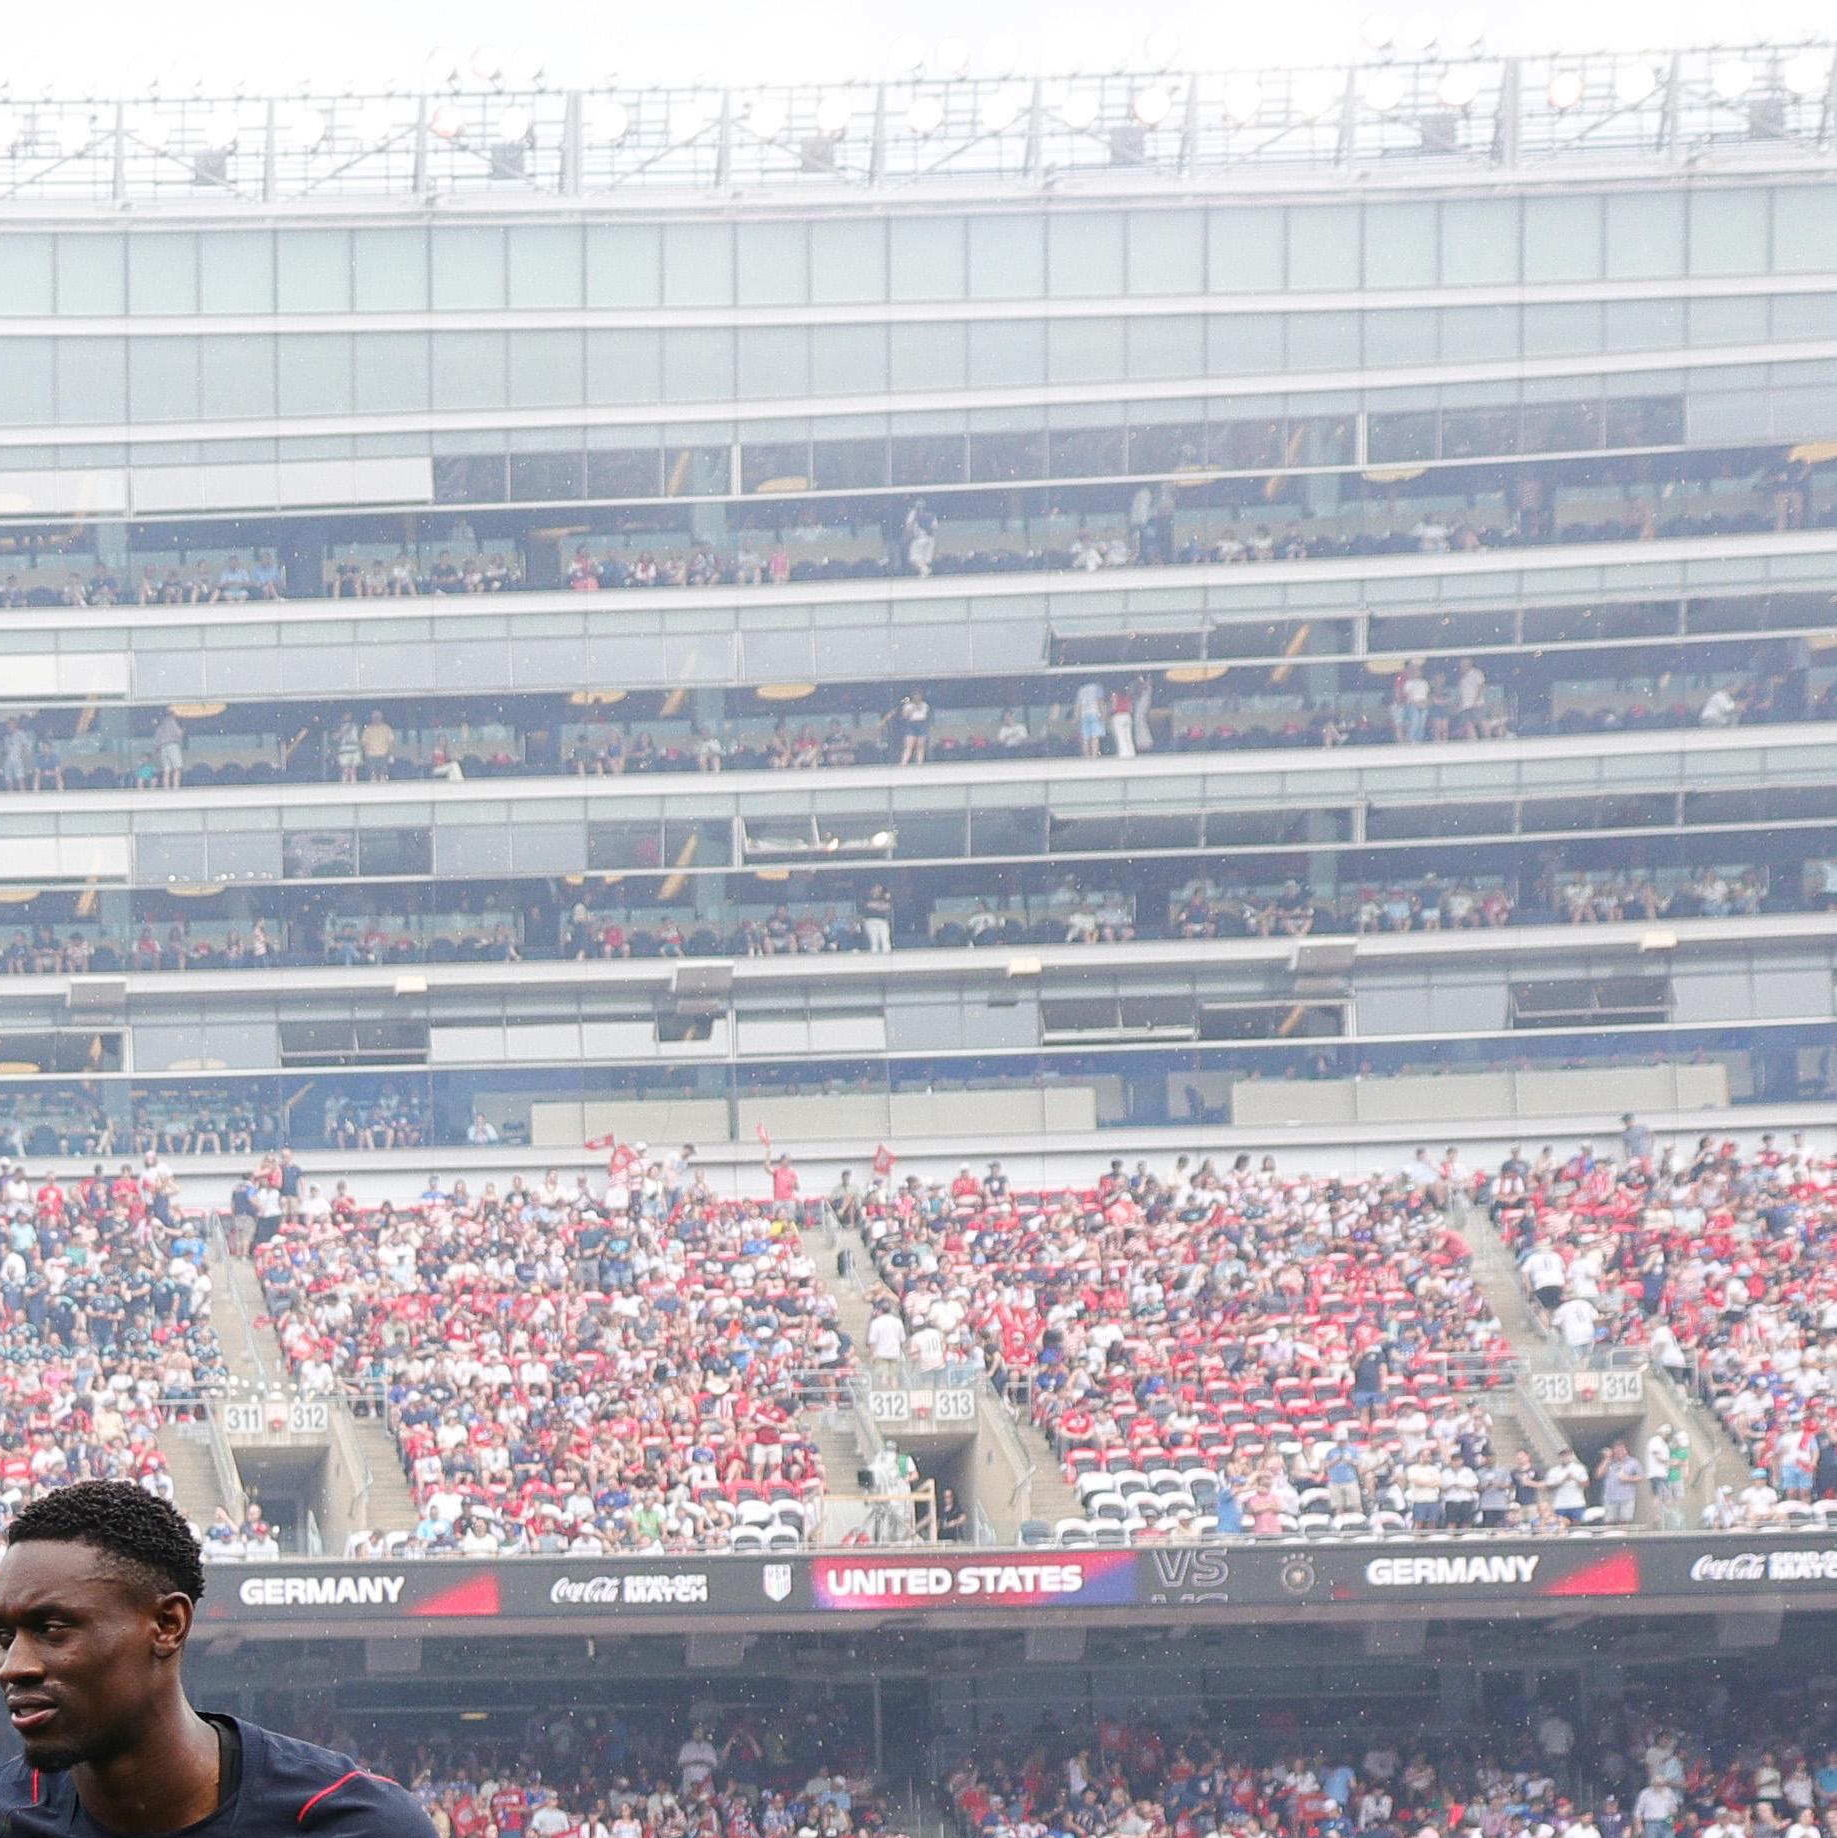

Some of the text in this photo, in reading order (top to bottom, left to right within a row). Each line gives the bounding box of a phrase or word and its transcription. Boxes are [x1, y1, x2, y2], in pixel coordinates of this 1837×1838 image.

[1536, 1377, 1569, 1399] 313
[1607, 1375, 1638, 1396] 314
[873, 1396, 904, 1417] 312
[939, 1394, 971, 1415] 313
[228, 1408, 259, 1429] 311
[294, 1407, 324, 1428] 312
[1151, 1549, 1229, 1588] VS
[1367, 1555, 1538, 1585] GERMANY
[239, 1576, 405, 1605] GERMANY
[828, 1564, 1083, 1597] UNITED STATES
[624, 1585, 708, 1603] MATCH
